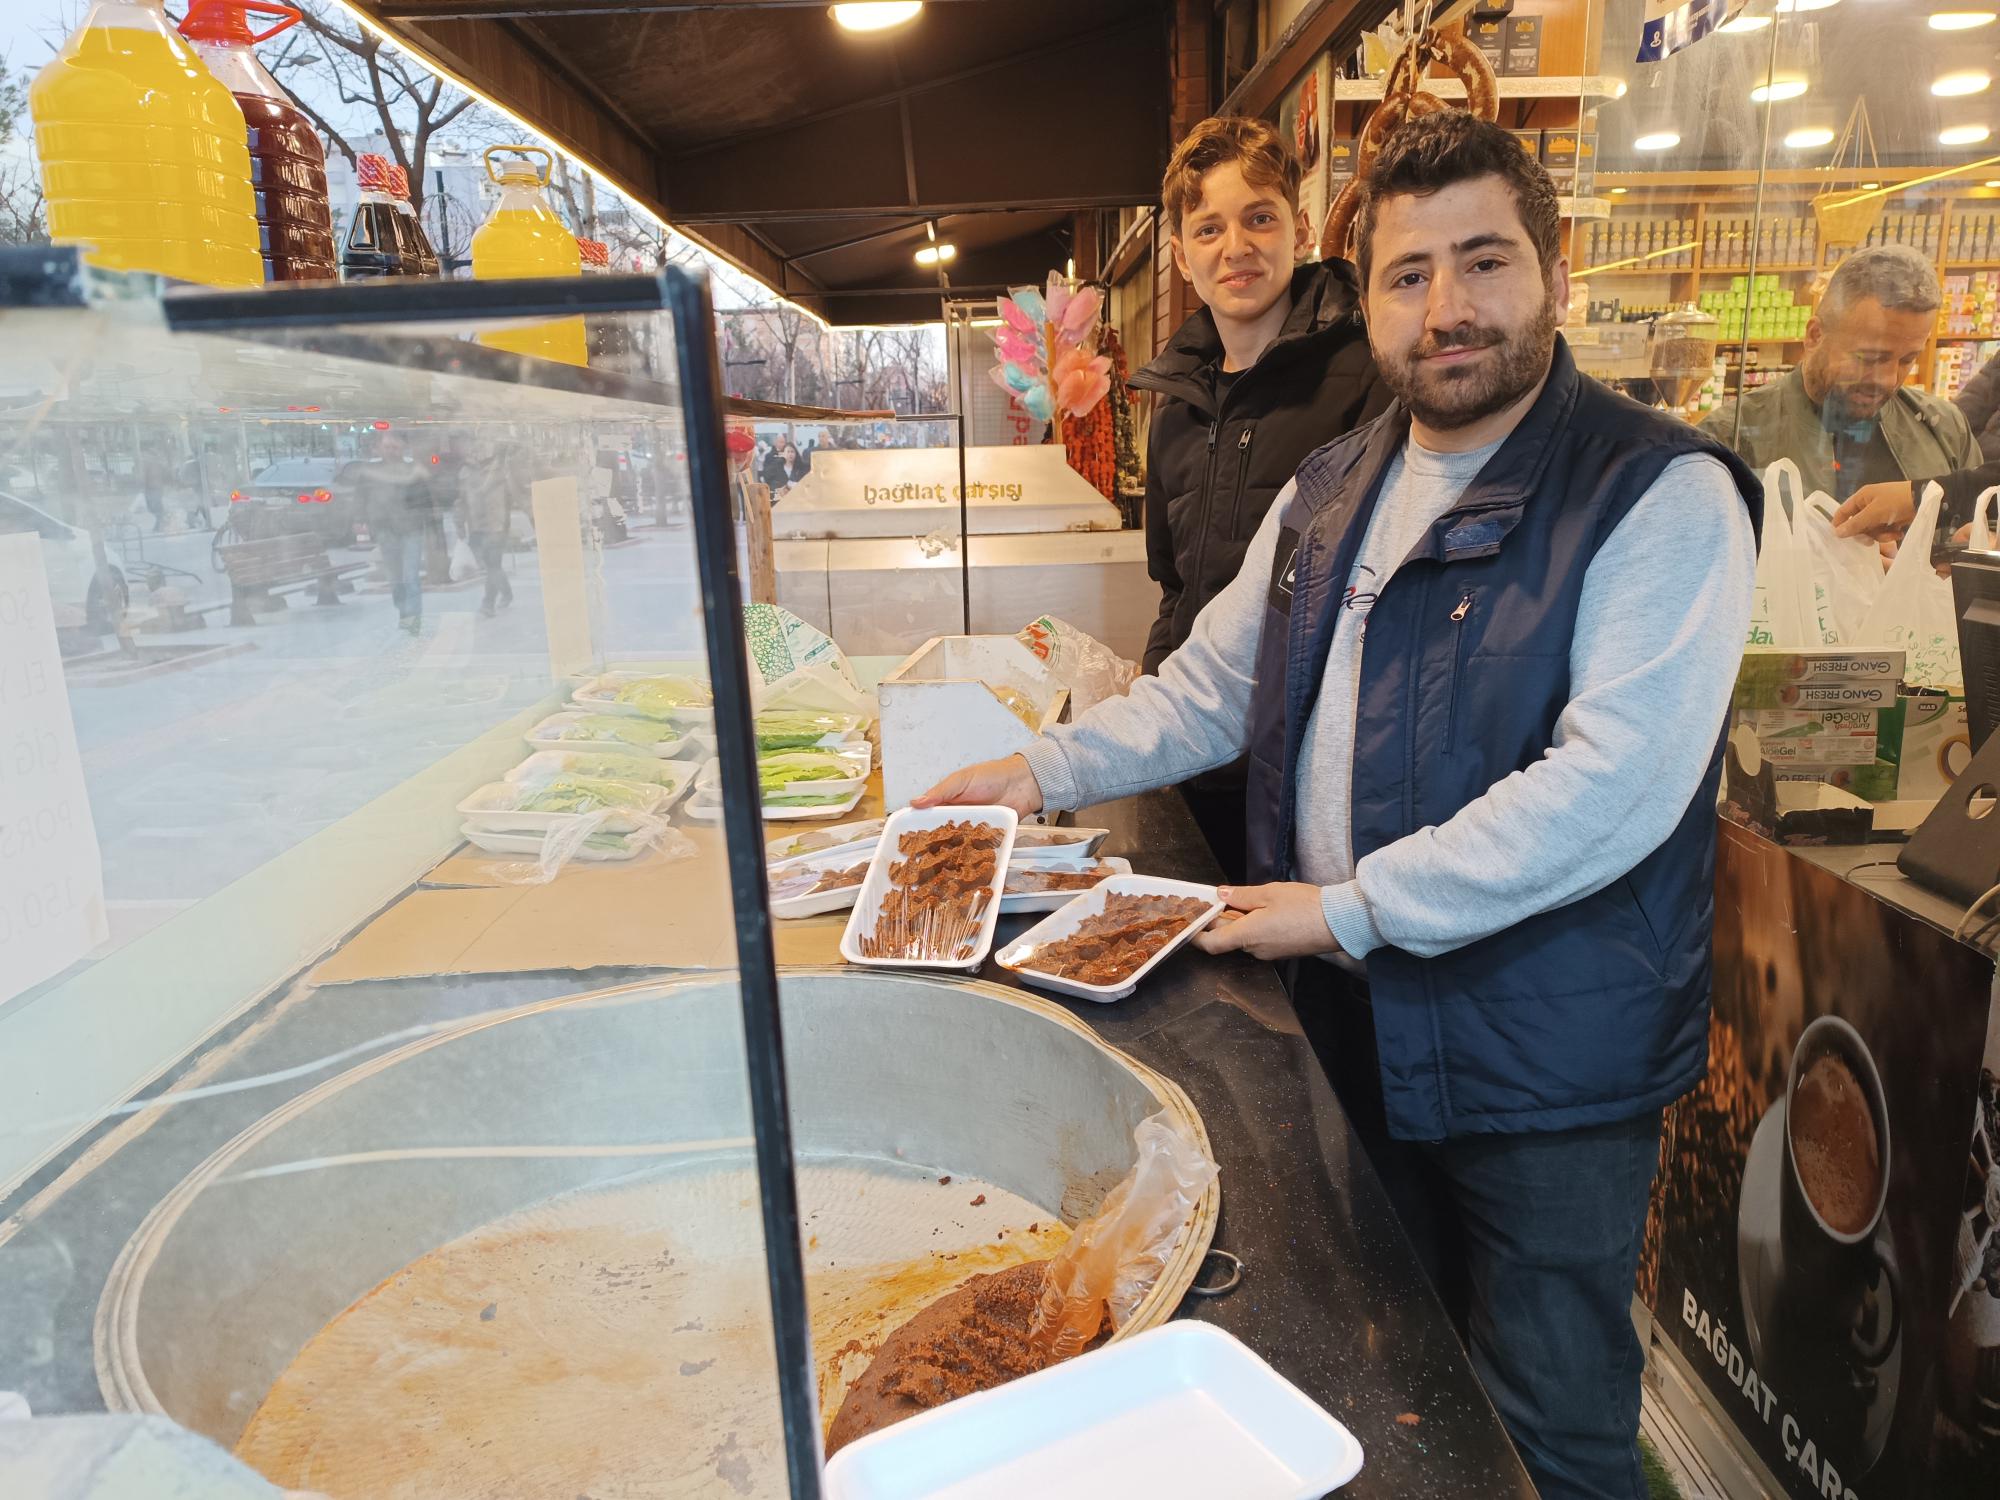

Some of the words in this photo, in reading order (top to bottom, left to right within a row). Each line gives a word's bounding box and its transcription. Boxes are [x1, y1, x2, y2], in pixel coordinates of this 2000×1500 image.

[1813, 661, 1848, 672] FRESH
[1851, 661, 1891, 674] GANO
[1805, 690, 1840, 700] FRESH
[1842, 689, 1882, 702] GANO
[1821, 711, 1871, 724] AloeGel
[1682, 1287, 1778, 1425] BAĞDAT
[1781, 1413, 1859, 1500] ÇAR
